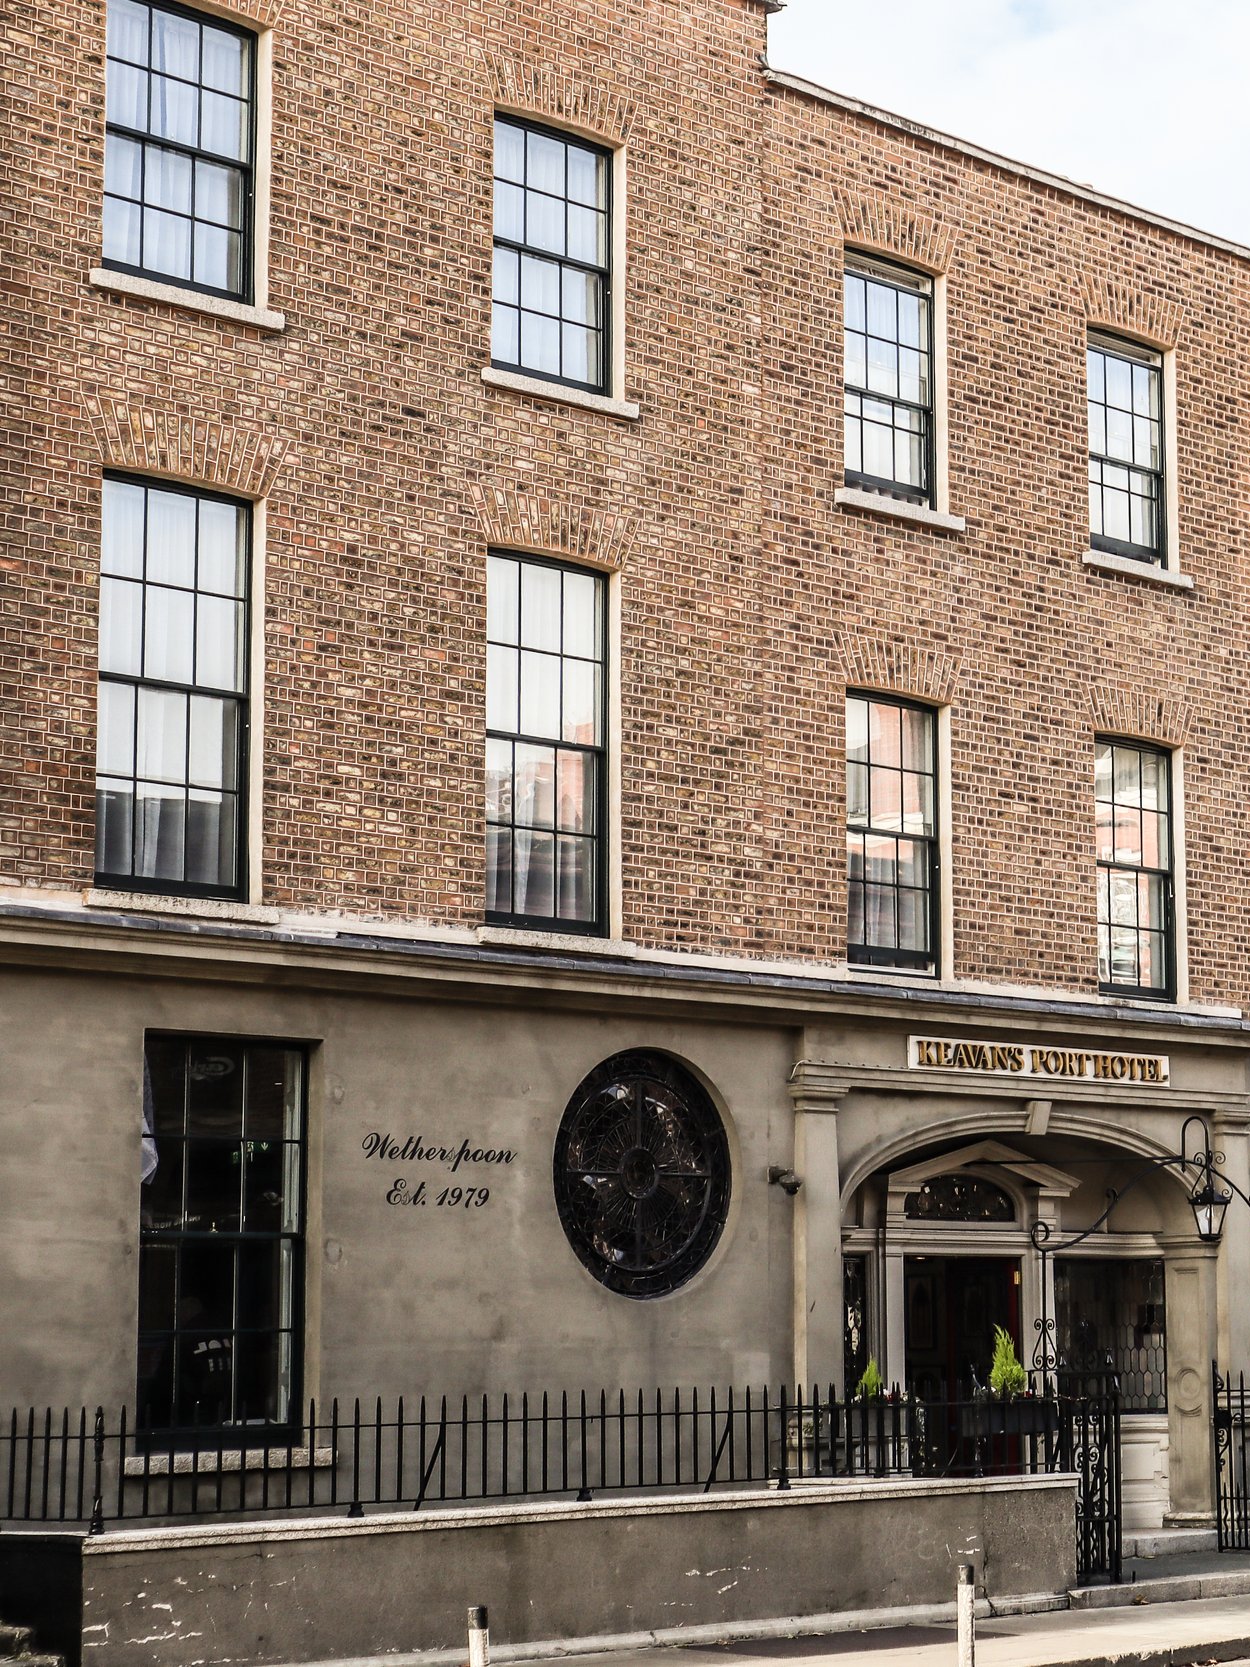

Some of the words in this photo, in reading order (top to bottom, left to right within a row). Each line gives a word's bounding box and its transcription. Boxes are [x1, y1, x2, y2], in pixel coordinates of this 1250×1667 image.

[917, 1040, 1025, 1072] KEAVAN'S
[1030, 1048, 1092, 1077] PORT
[1093, 1054, 1169, 1082] HOTEL
[361, 1132, 518, 1172] Wetherspoon
[386, 1178, 427, 1206] Est.
[435, 1187, 490, 1208] 1979
